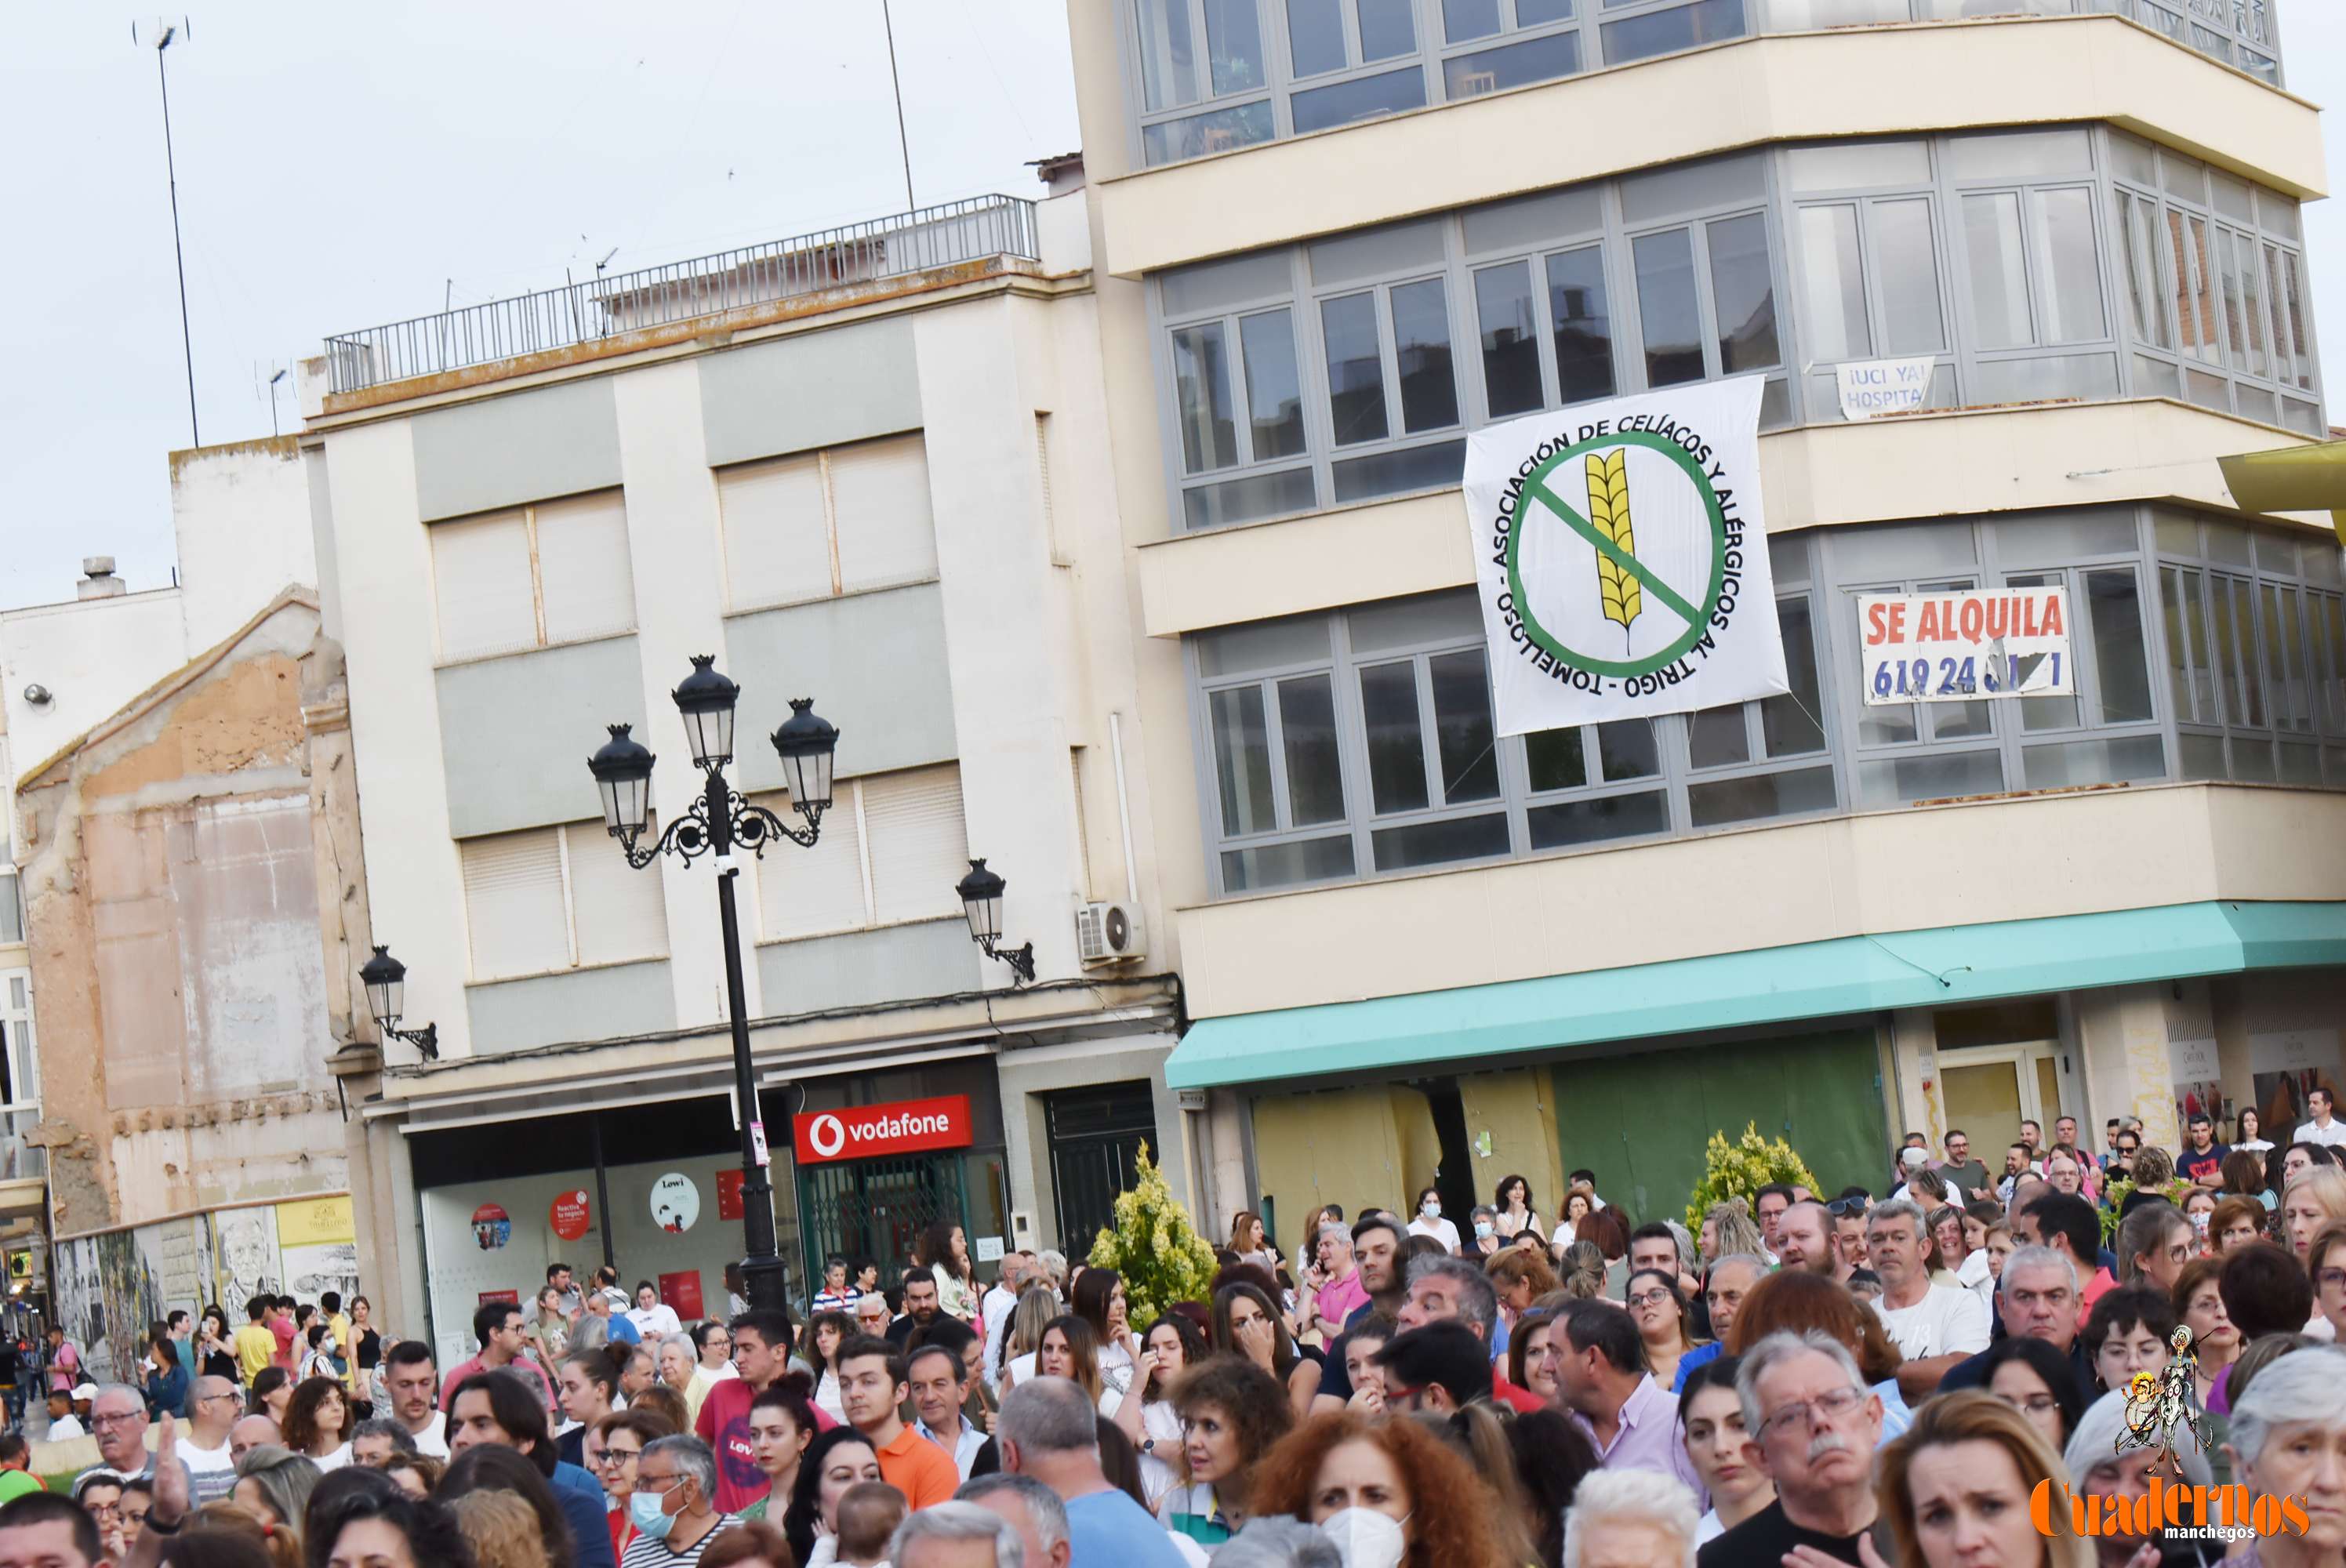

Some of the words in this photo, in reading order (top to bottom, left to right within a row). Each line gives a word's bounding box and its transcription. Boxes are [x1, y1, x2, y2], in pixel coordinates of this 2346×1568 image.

[1850, 369, 1887, 385] ¡UCI
[1896, 365, 1926, 382] YA!
[1578, 419, 1610, 442] DE
[1617, 414, 1712, 466] CELÍACOS
[1708, 461, 1726, 481] Y
[1492, 433, 1571, 567] ASOCIACIÓN
[1711, 488, 1746, 631] ALÉRGICOS
[1867, 602, 1906, 645] SE
[1916, 595, 2064, 645] ALQUILA
[1497, 592, 1602, 696] TOMELLOSO
[1690, 630, 1716, 659] AL
[1625, 658, 1697, 698] TRIGO
[1874, 658, 1930, 696] 619
[848, 1112, 949, 1142] vodafone
[662, 1178, 685, 1189] Lowi
[729, 1439, 754, 1456] Lev
